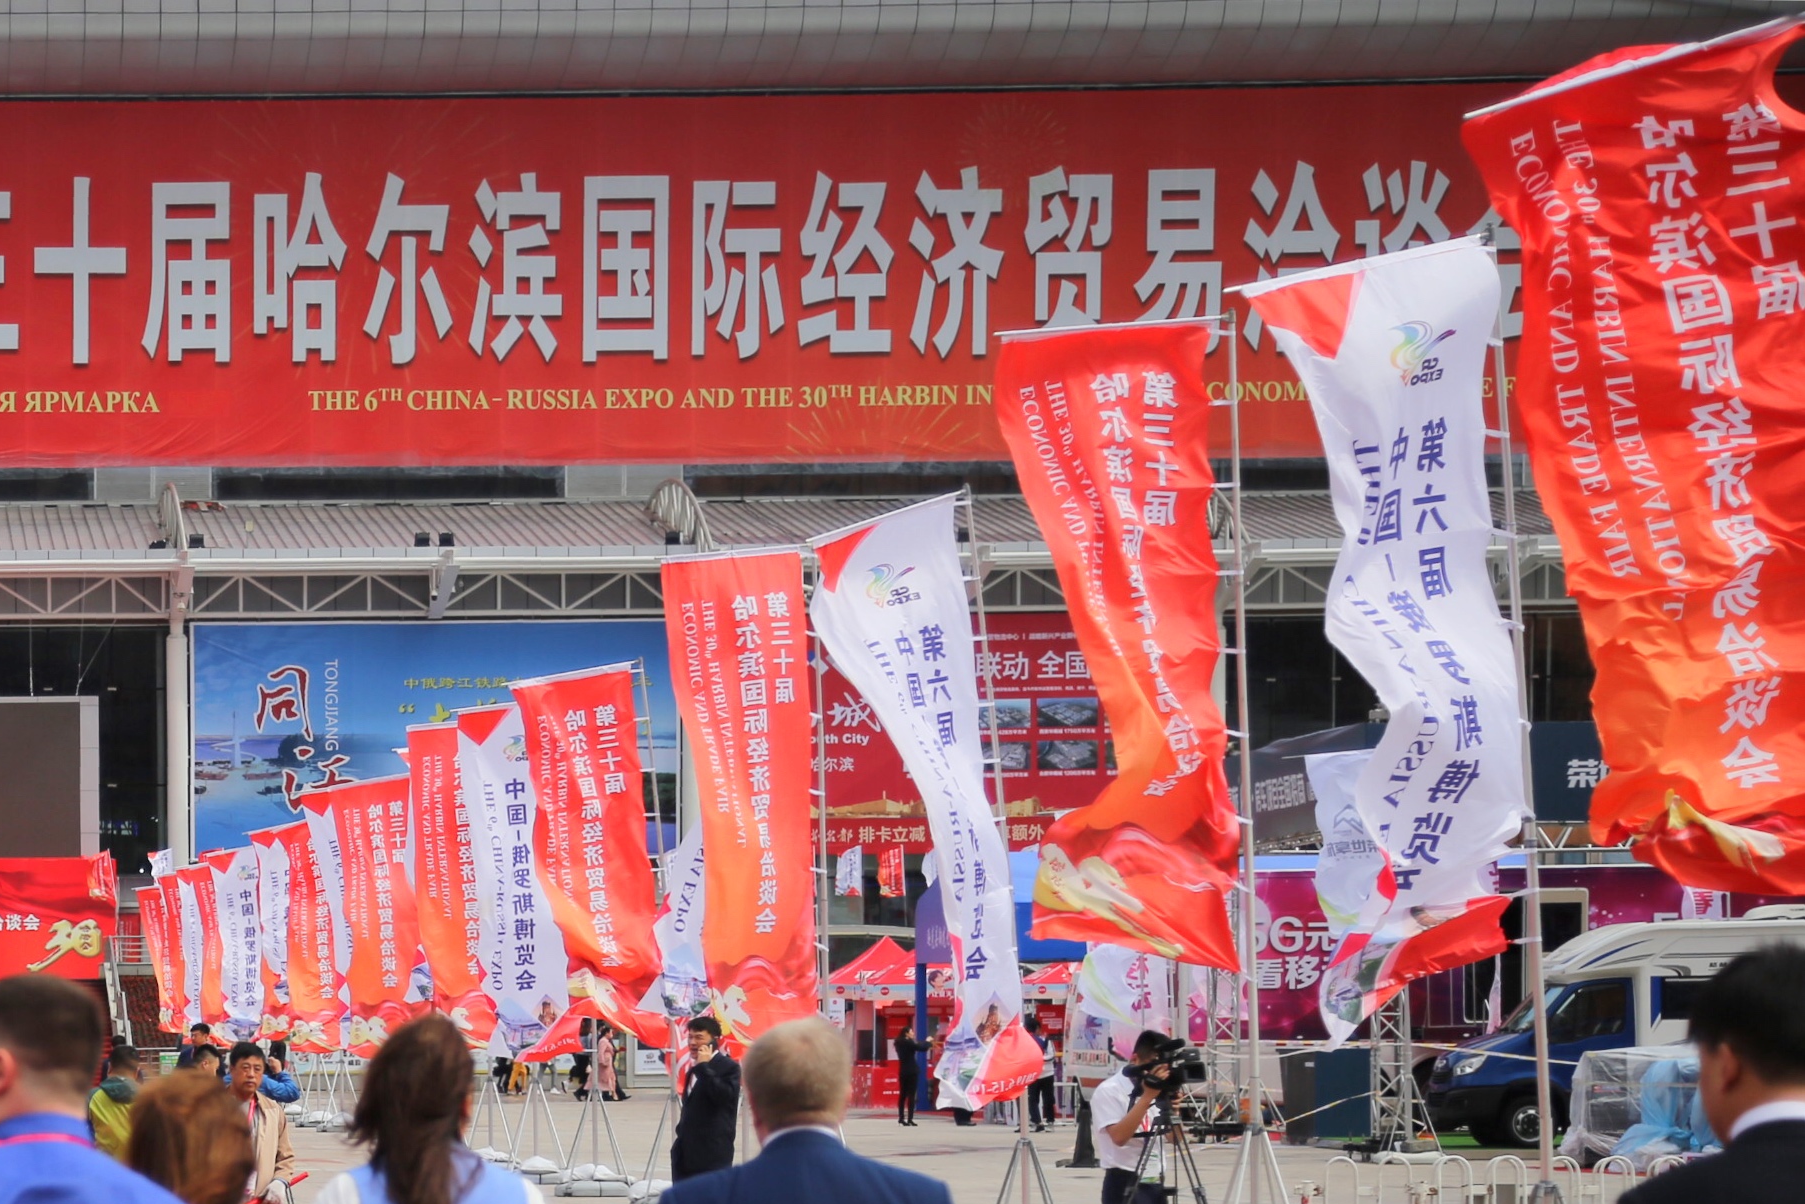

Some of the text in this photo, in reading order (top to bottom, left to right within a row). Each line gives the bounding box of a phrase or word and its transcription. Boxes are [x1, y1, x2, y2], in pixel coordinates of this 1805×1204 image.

[23, 390, 161, 413] ЯРМАРКА
[307, 390, 360, 411] THE
[364, 388, 403, 411] 6TH
[604, 387, 674, 409] EXPO
[680, 387, 735, 409] AND
[741, 386, 794, 408] THE
[798, 384, 852, 408] 30TH
[858, 383, 959, 407] HARBIN
[1037, 650, 1092, 680] 全国
[323, 658, 339, 752] TONGJIANG
[844, 734, 870, 746] City
[858, 826, 926, 844] 排卡立减
